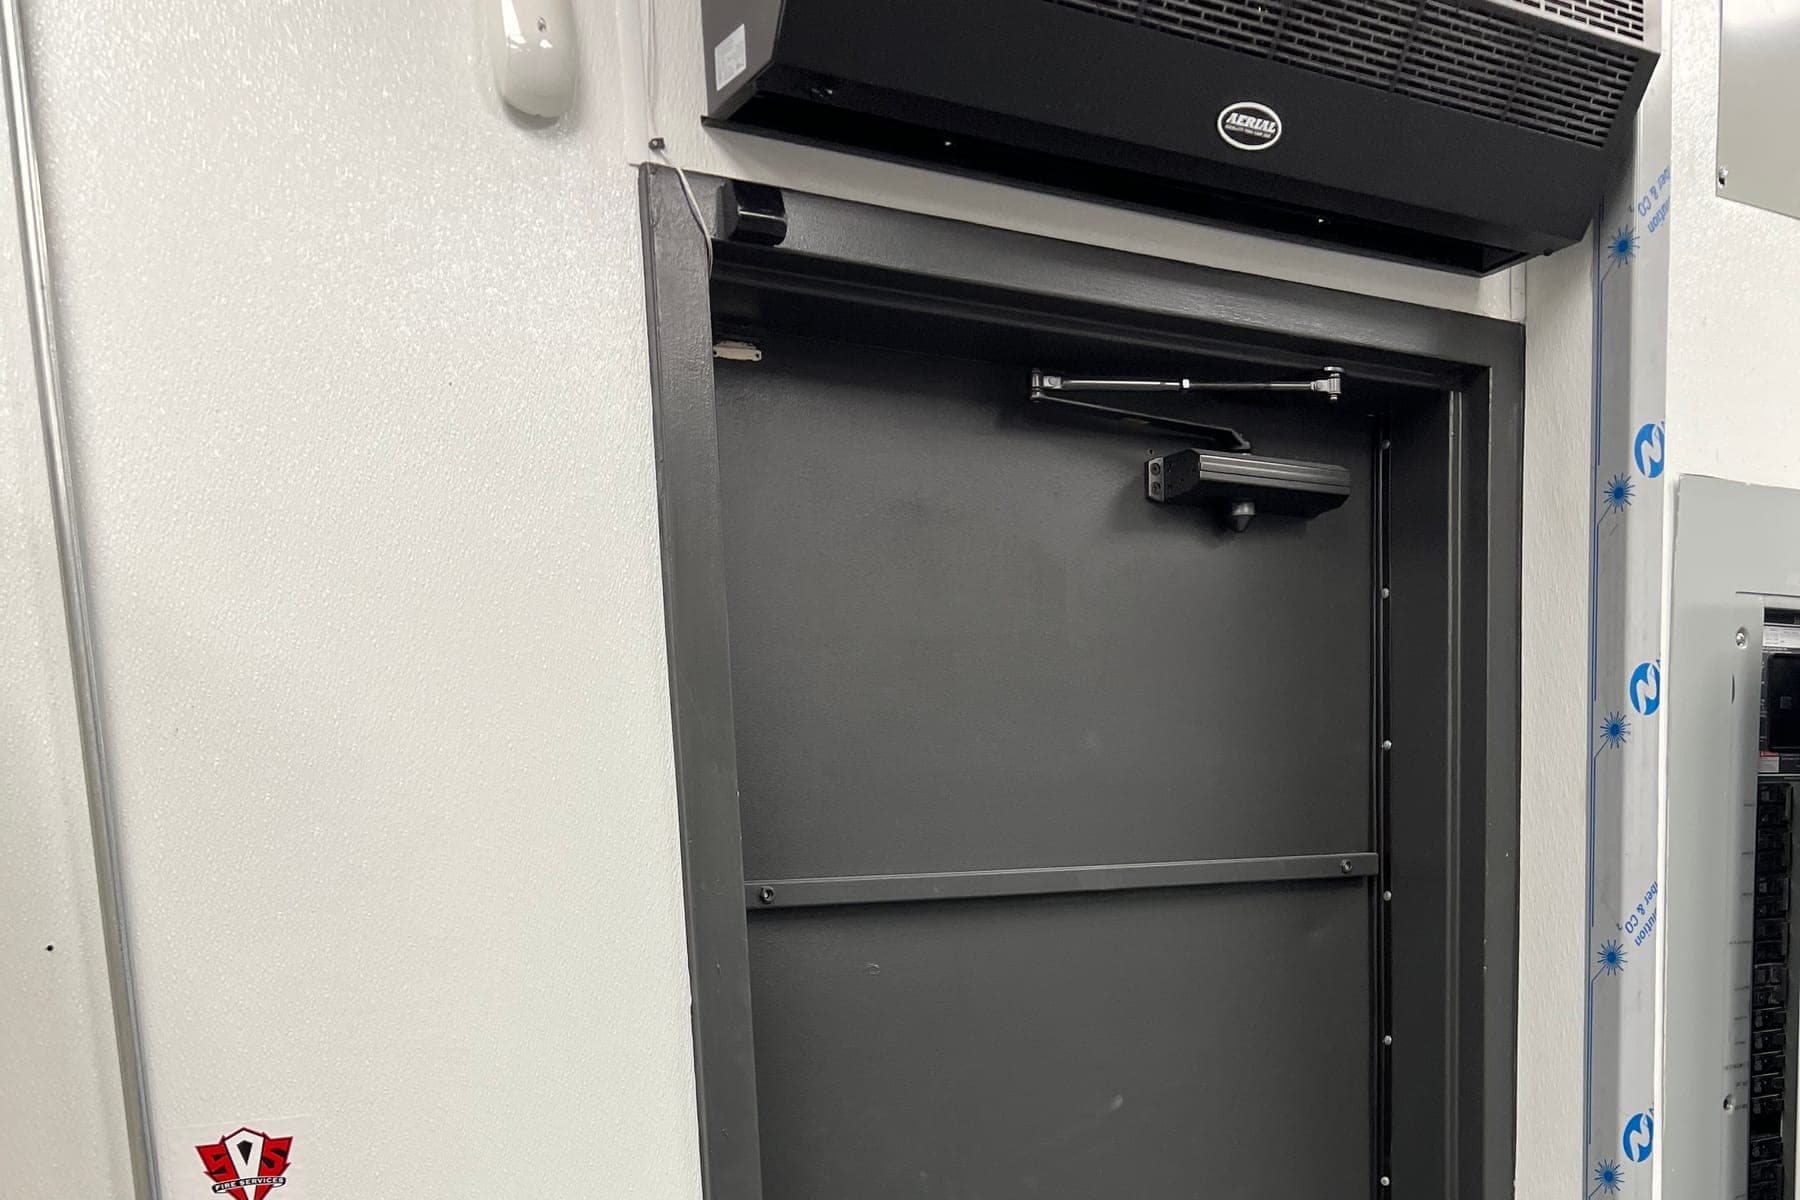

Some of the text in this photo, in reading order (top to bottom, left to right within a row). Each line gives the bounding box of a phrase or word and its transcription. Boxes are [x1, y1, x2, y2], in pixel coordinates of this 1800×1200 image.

[1226, 112, 1276, 133] AERIAL
[215, 1177, 284, 1191] FIRE SERVICES
